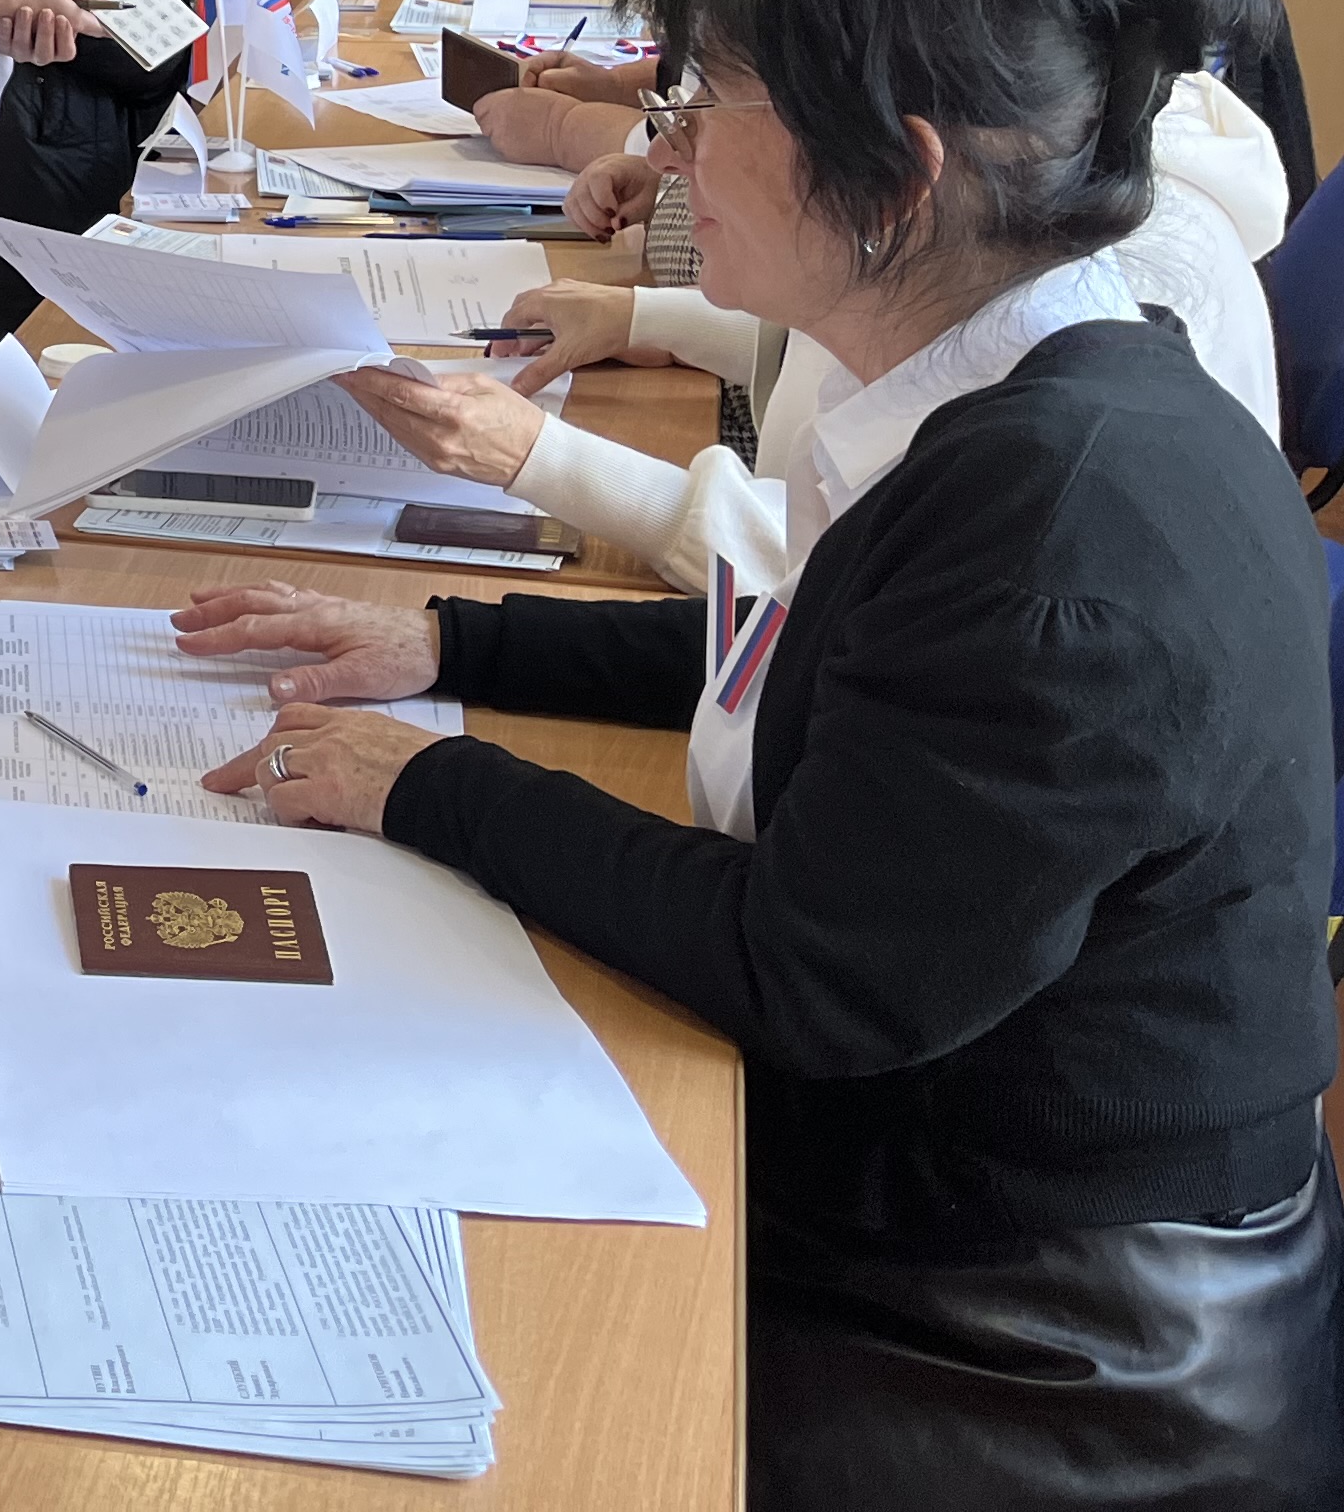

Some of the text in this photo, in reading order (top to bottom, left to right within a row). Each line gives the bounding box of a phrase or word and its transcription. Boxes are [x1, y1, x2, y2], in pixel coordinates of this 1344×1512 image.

[95, 880, 116, 951] РОССИЙСКАЯ
[113, 886, 133, 947] ФЕДЕРАЦИЯ
[260, 886, 302, 961] ПАСПОРТ
